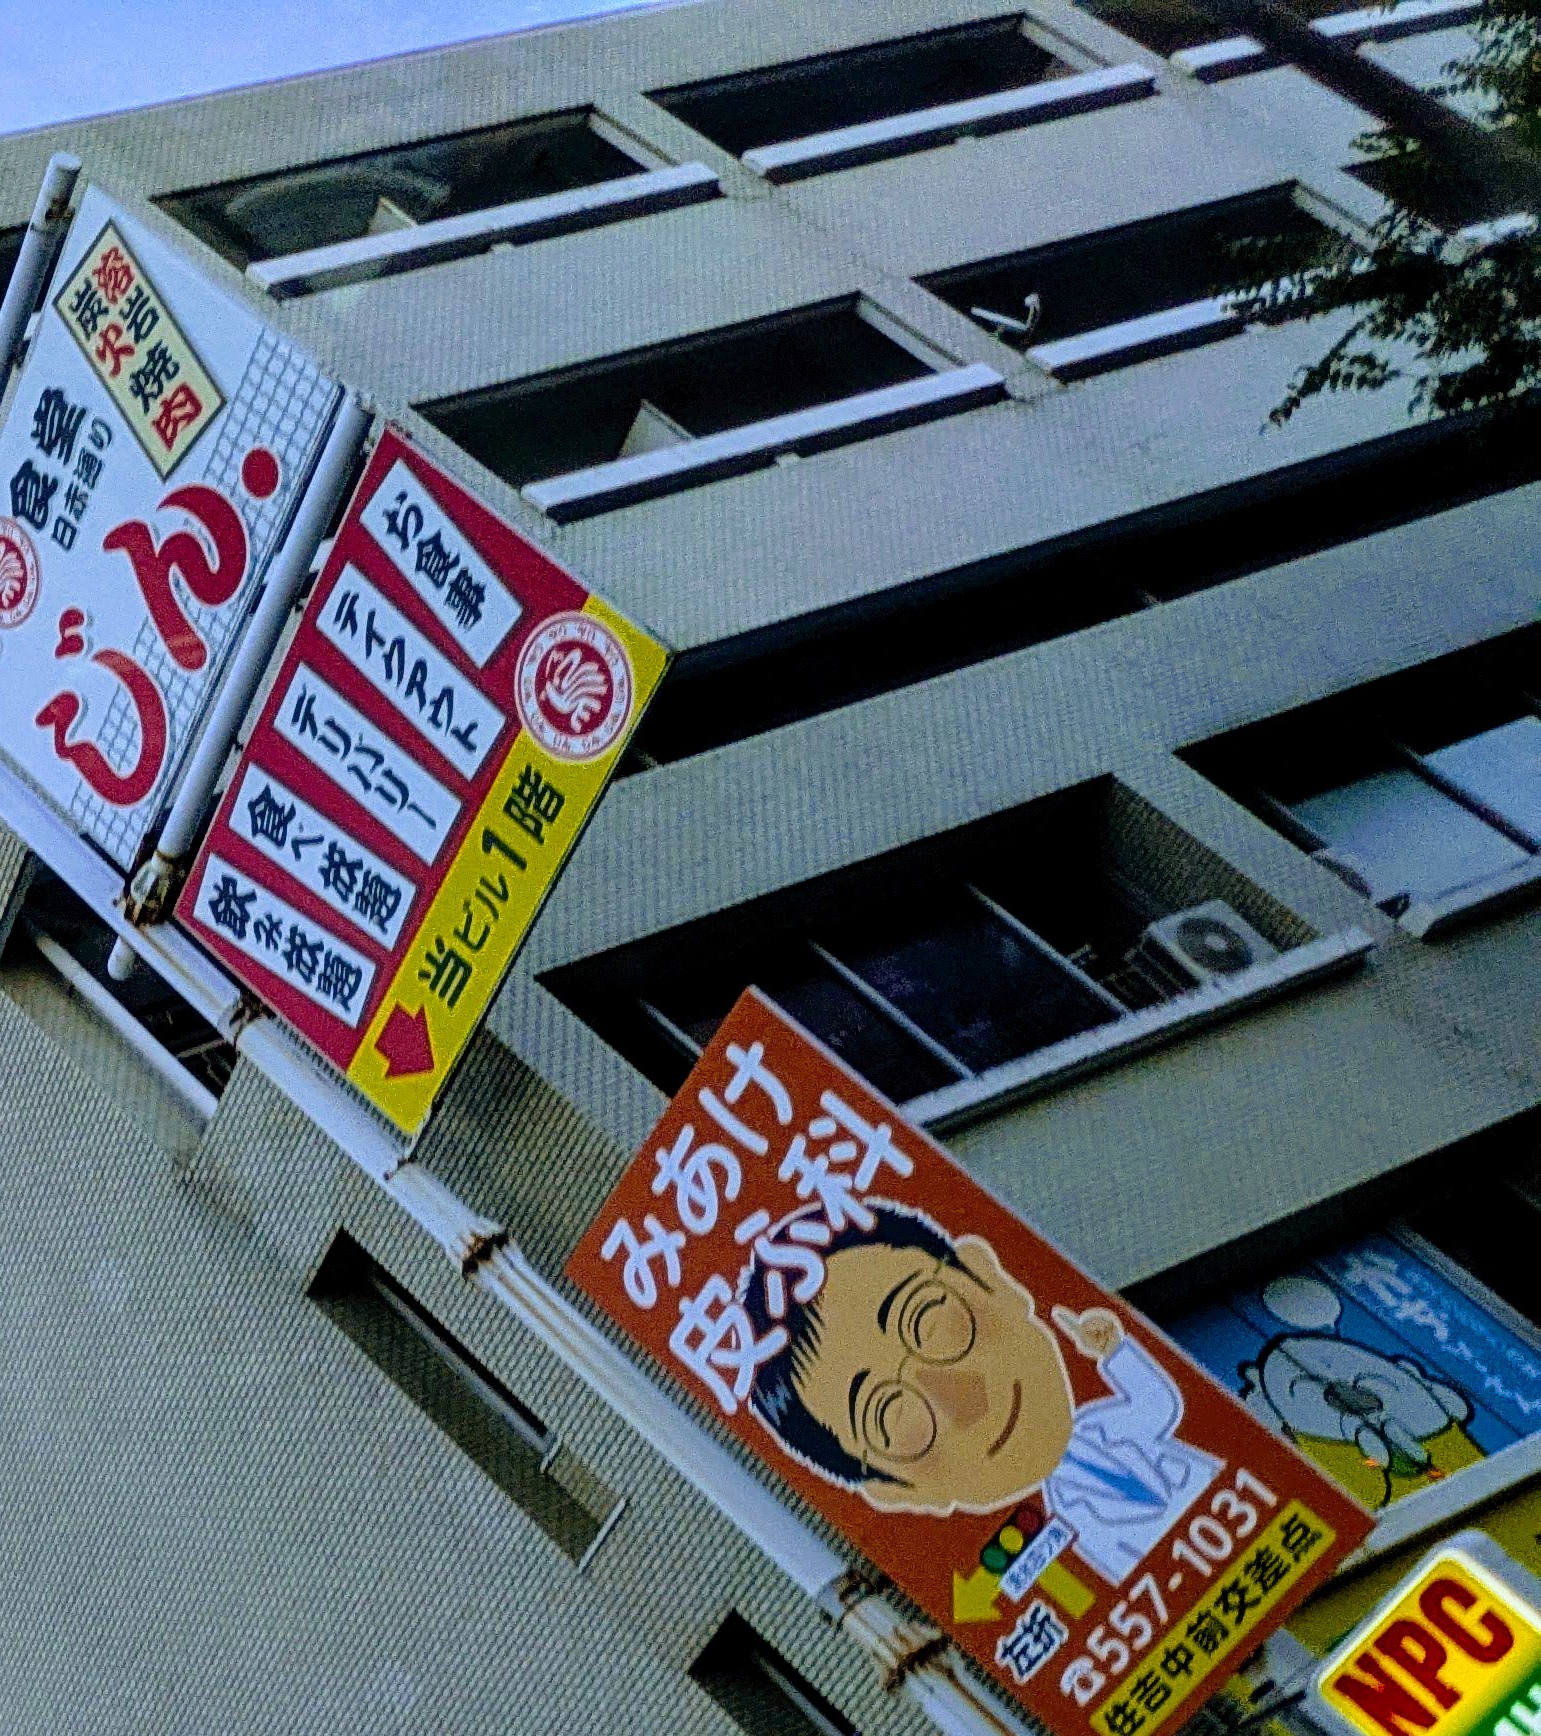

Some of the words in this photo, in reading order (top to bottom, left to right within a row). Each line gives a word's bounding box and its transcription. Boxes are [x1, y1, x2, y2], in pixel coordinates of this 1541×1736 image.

[68, 280, 135, 377] 炭火
[93, 246, 161, 342] 溶岩
[10, 386, 88, 531] 食堂
[129, 340, 204, 451] 焼肉
[51, 415, 113, 552] 日赤通り
[384, 490, 487, 631] お食事
[333, 591, 481, 754] テイクアウト
[291, 682, 436, 830] デリバリー
[247, 784, 402, 934] 食べ放題
[418, 762, 566, 1009] 当ビル1階
[209, 875, 363, 1013] 飲み放題
[602, 1039, 793, 1310] みあけ
[670, 1090, 915, 1413] 皮ふ科
[999, 1605, 1065, 1677] 左折
